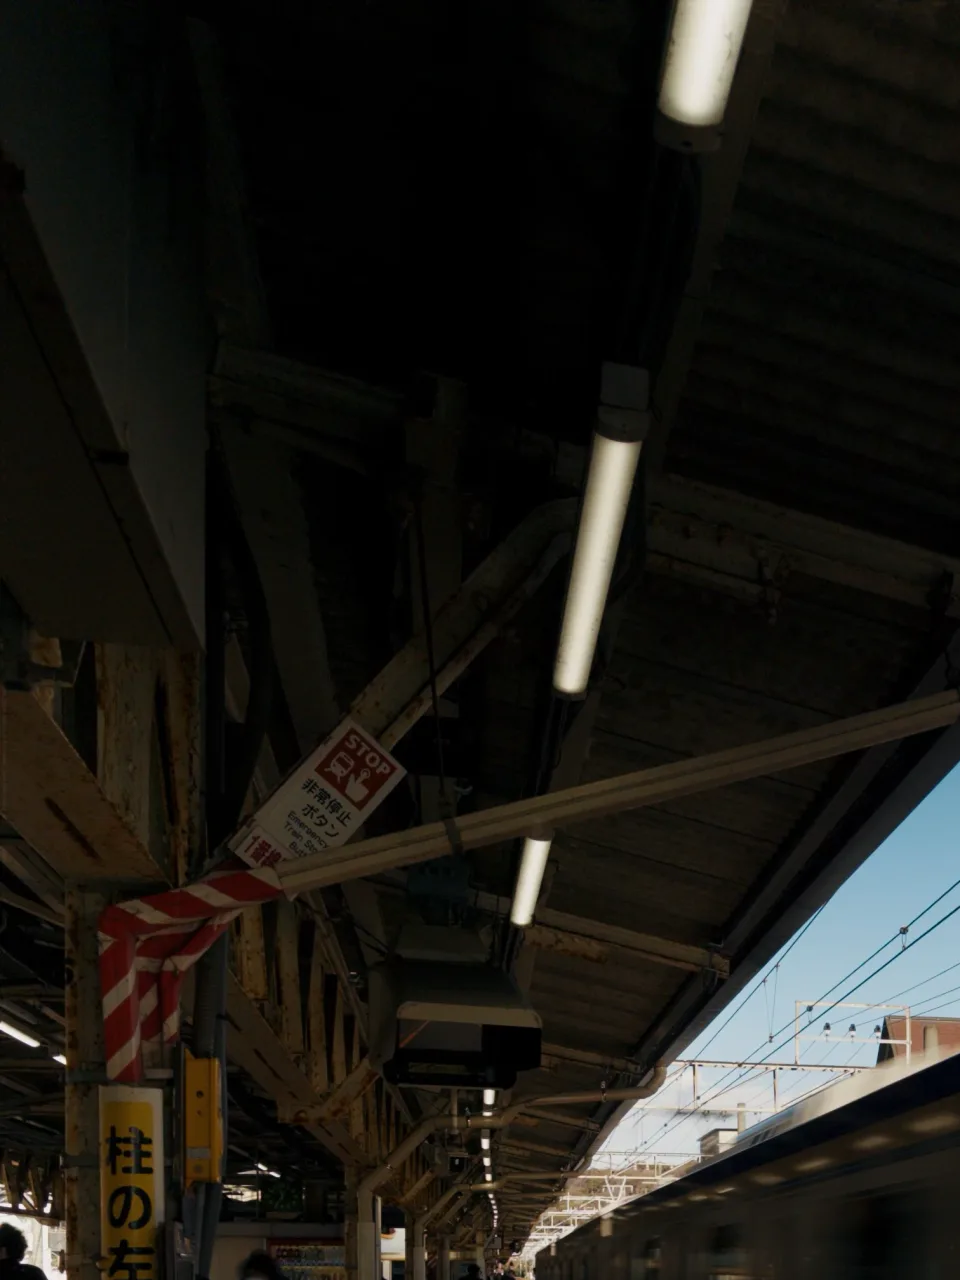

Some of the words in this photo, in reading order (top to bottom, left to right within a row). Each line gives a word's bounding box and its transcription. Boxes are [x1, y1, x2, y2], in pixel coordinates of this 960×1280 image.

[345, 733, 392, 774] STOP
[301, 778, 352, 828] 非常停止
[301, 804, 339, 838] ボタン
[284, 821, 303, 841] Train
[304, 839, 319, 853] Sto
[288, 810, 329, 849] Emergency
[244, 835, 284, 868] 1番線
